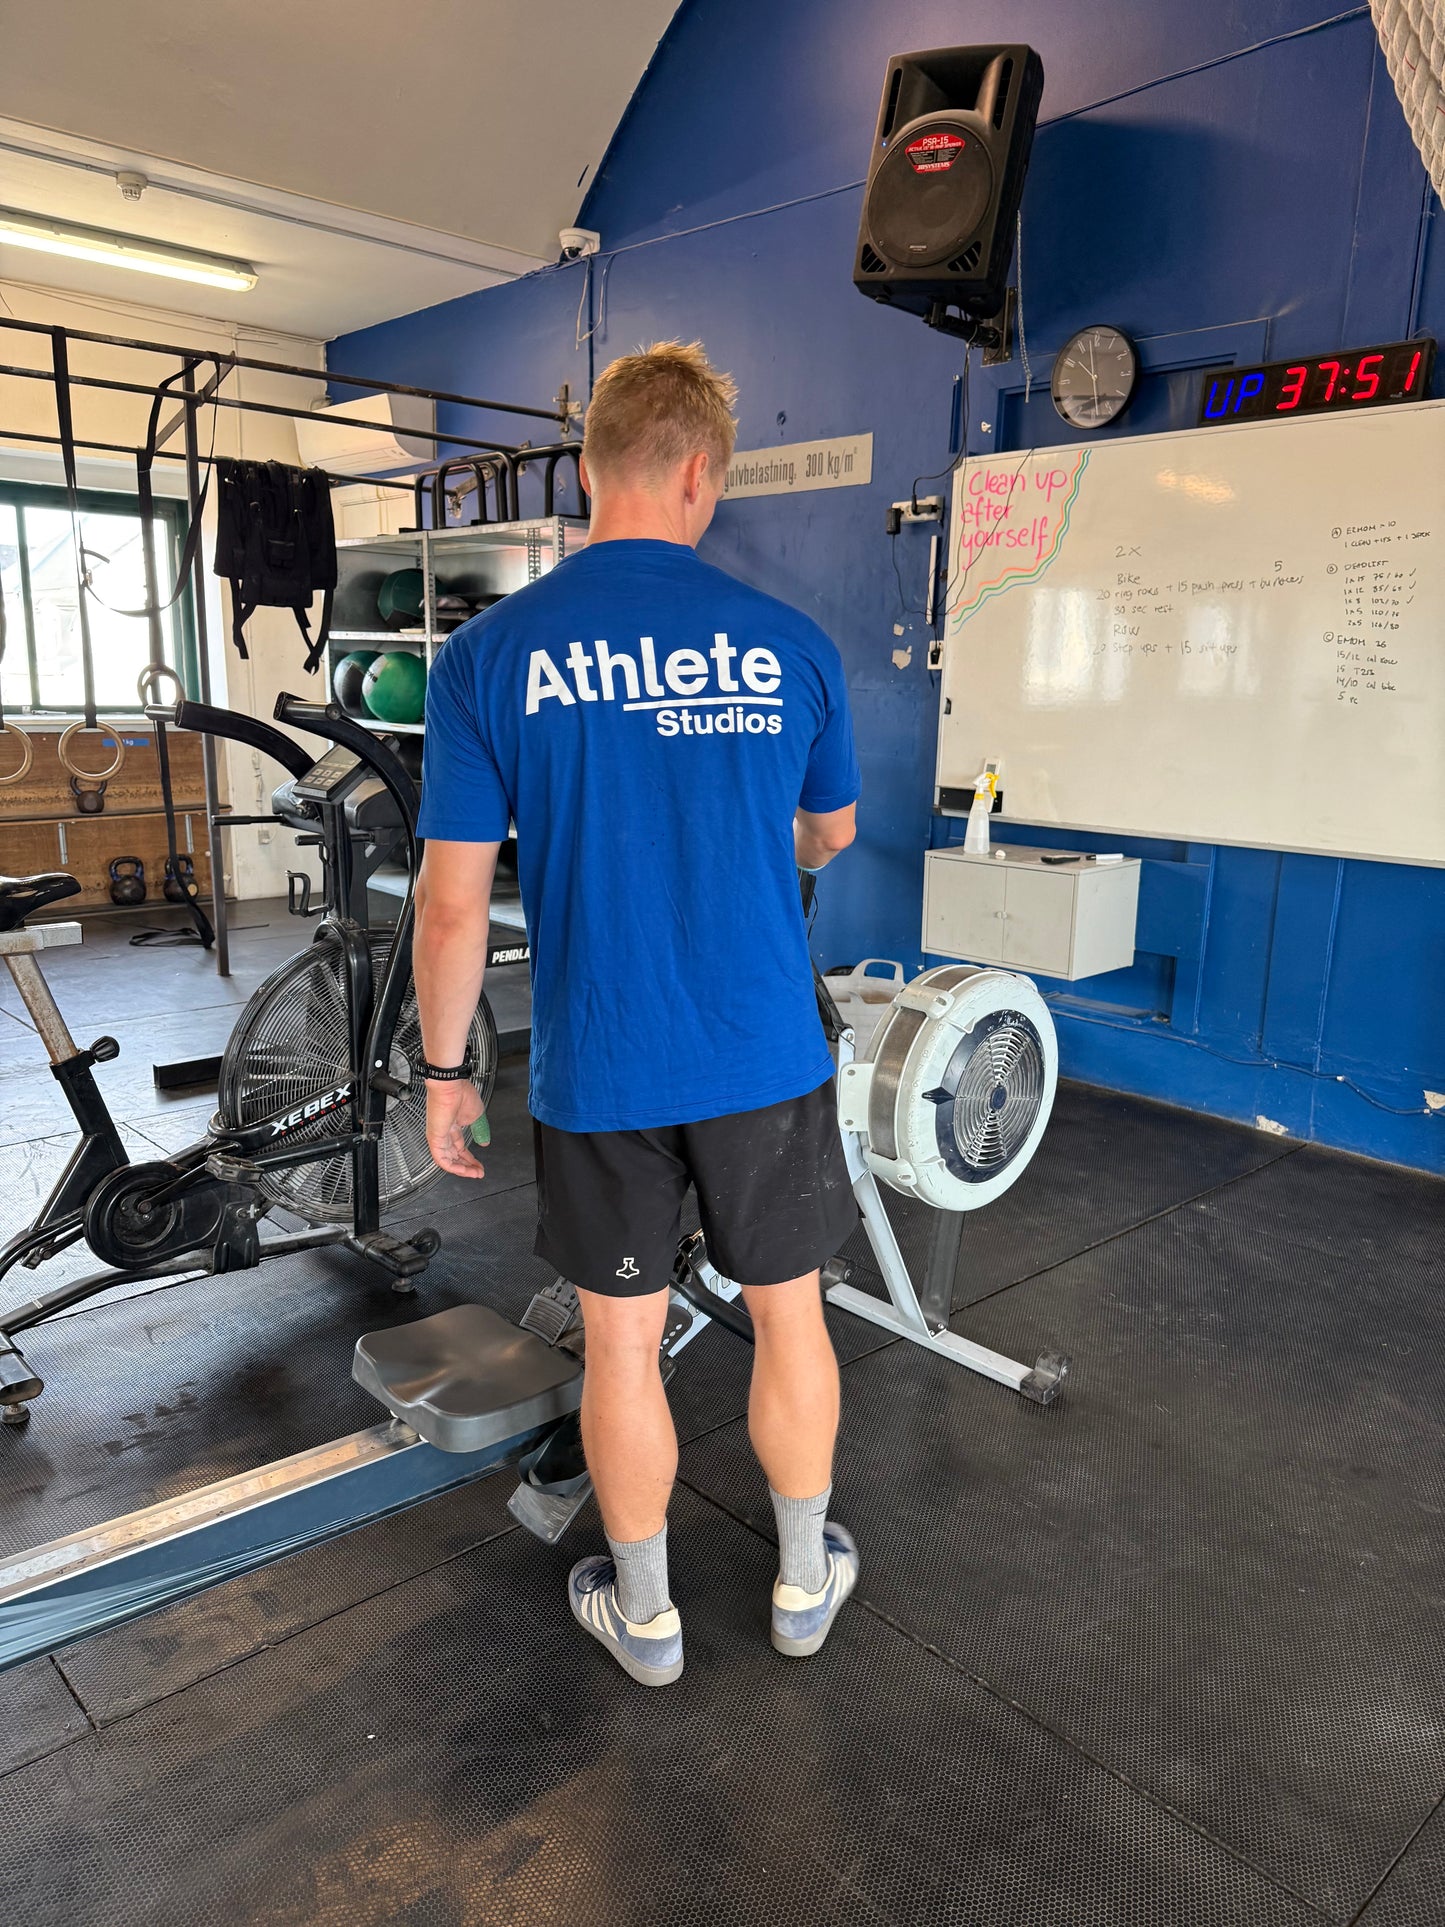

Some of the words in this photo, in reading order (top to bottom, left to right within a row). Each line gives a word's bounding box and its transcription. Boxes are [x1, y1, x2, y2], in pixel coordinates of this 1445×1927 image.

[923, 136, 949, 146] PSA-15
[1205, 373, 1265, 419] UP
[1276, 351, 1421, 410] 37:51
[805, 452, 824, 478] 300
[968, 469, 1026, 496] Clean
[1035, 469, 1068, 502] up
[960, 496, 1015, 528] after
[961, 516, 1049, 571] yourself
[1274, 560, 1284, 572] 5
[1166, 584, 1174, 593] +
[1178, 580, 1189, 592] 15
[1131, 605, 1148, 615] sec
[1153, 604, 1175, 614] rest
[1165, 643, 1173, 654] +
[1181, 640, 1192, 655] 15
[525, 632, 782, 716] Athlete
[656, 706, 783, 737] Studios
[270, 1082, 352, 1137] XEBEX
